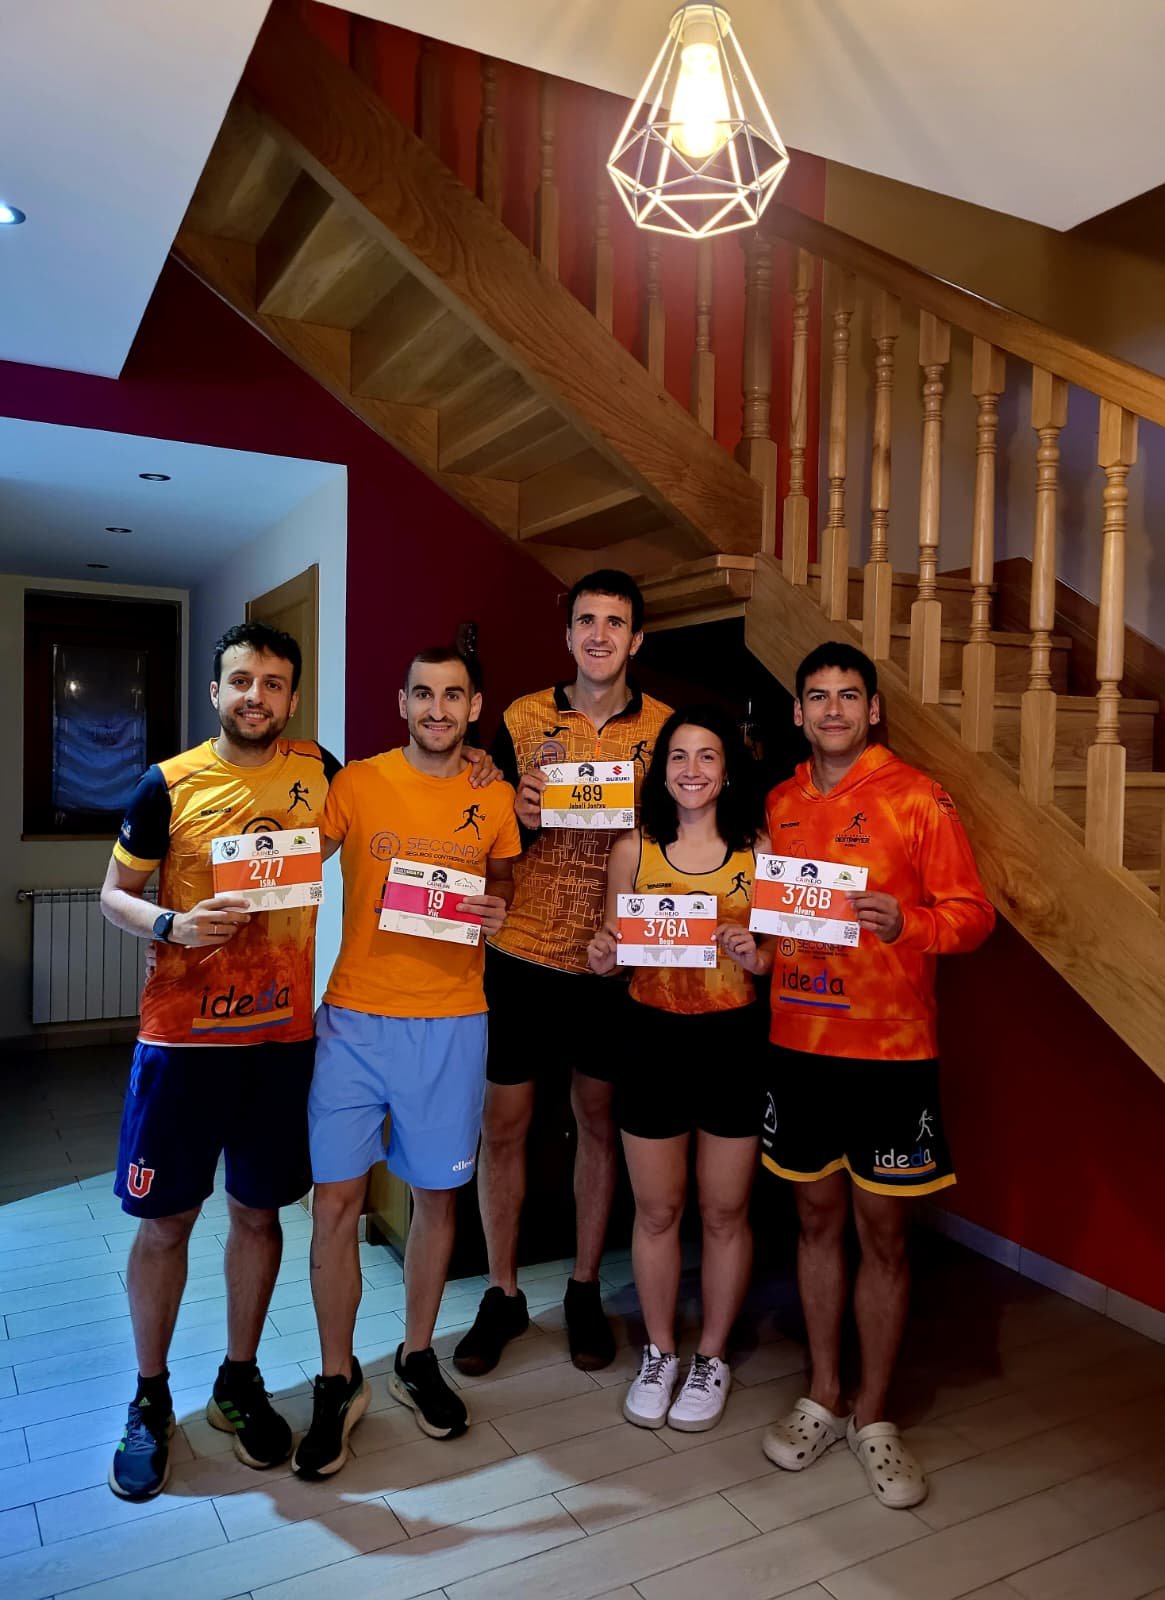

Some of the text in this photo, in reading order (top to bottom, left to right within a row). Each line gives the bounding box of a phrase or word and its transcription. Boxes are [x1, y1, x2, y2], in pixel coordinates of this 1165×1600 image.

[571, 784, 602, 802] 489
[406, 837, 483, 858] SECONAY
[248, 857, 284, 880] 277
[259, 878, 276, 888] ISRA
[427, 889, 445, 910] 19
[781, 883, 832, 910] 376B
[643, 918, 689, 938] 376A
[781, 965, 845, 996] ideda
[201, 980, 290, 1018] ideda
[874, 1147, 933, 1168] ideda
